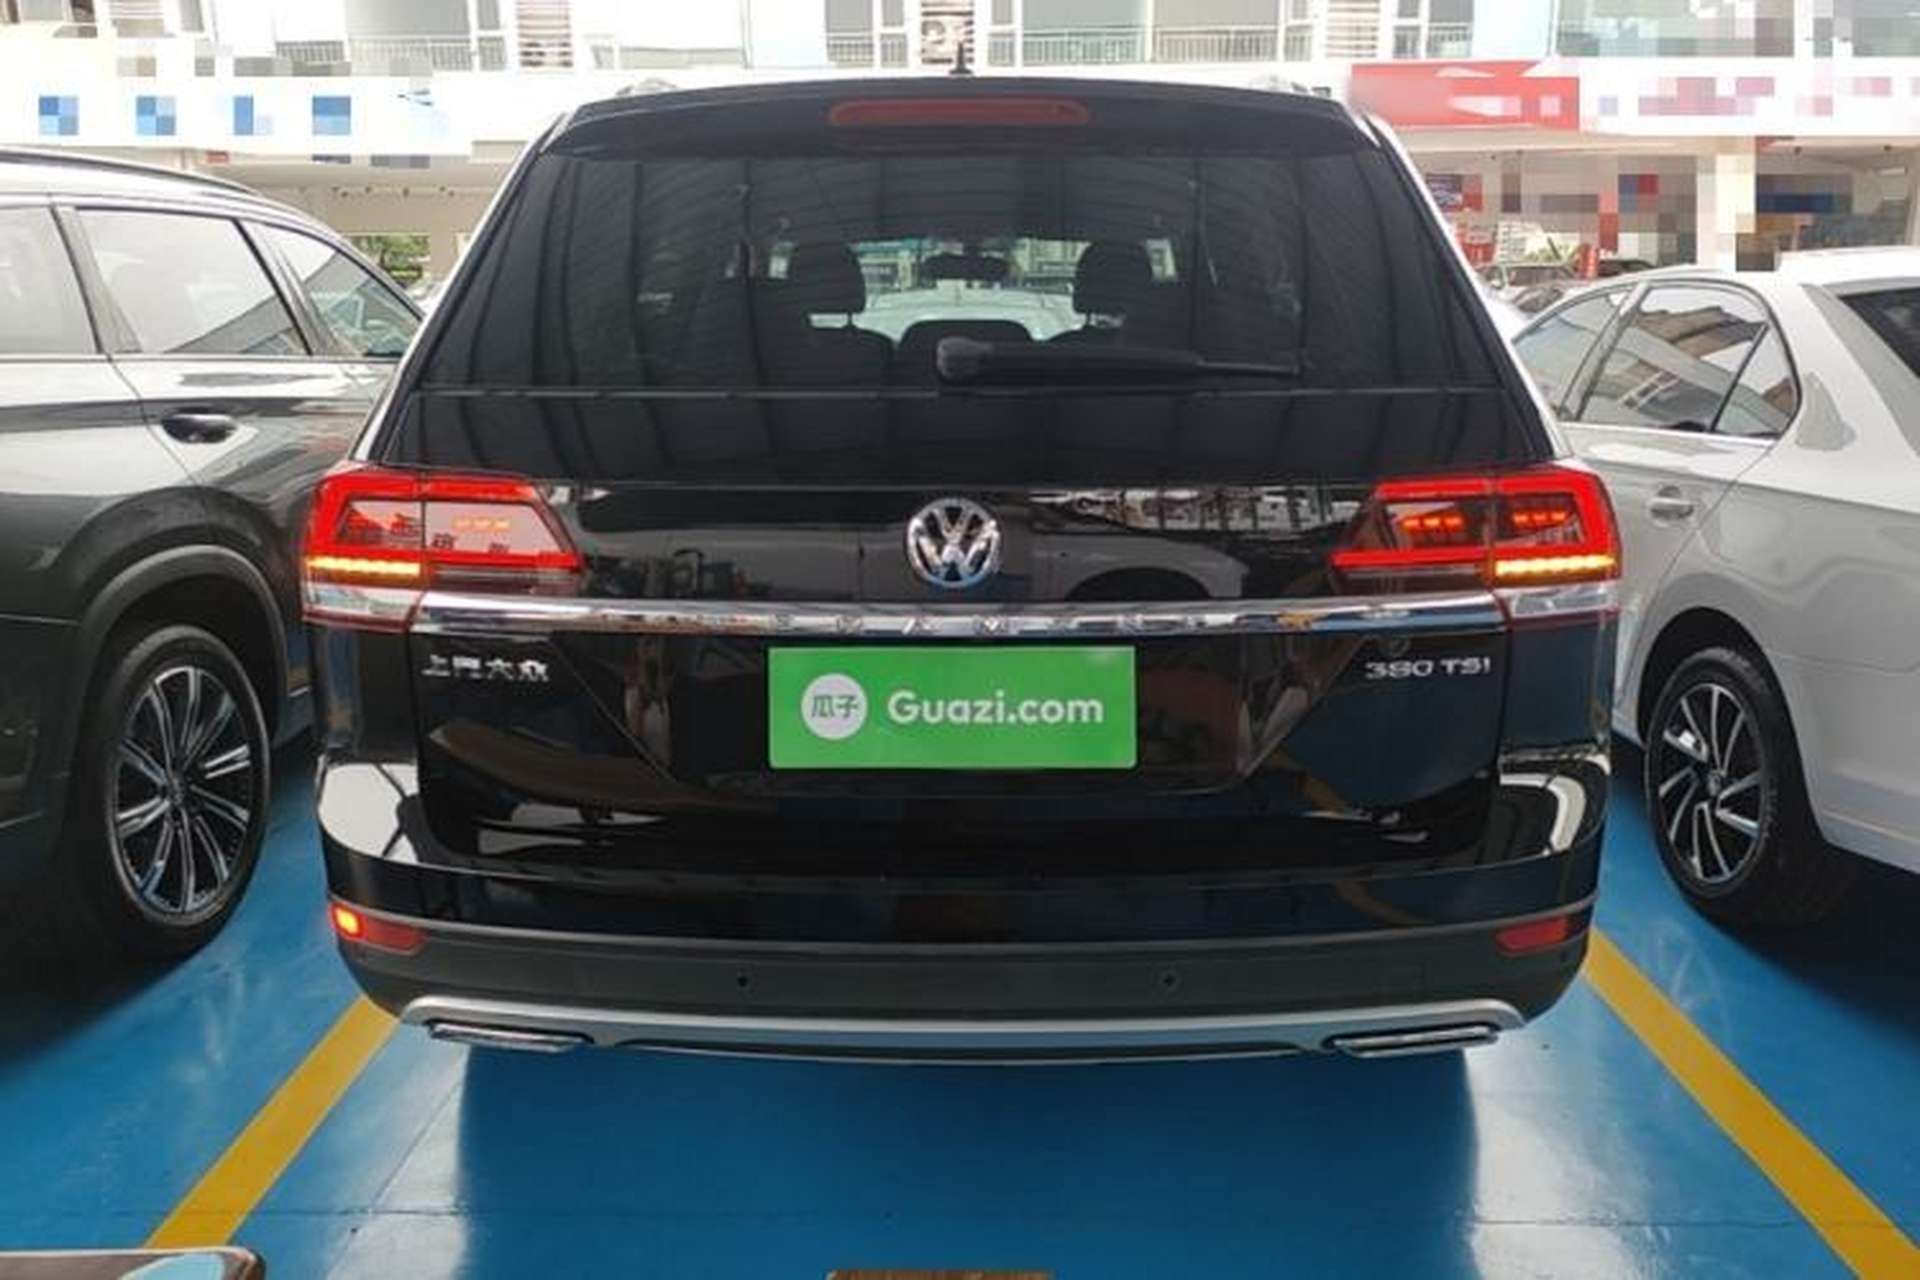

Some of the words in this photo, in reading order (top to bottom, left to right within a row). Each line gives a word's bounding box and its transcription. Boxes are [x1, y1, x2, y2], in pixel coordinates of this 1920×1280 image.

[908, 498, 999, 587] VW
[1365, 660, 1434, 679] 380
[1440, 657, 1491, 675] TSI
